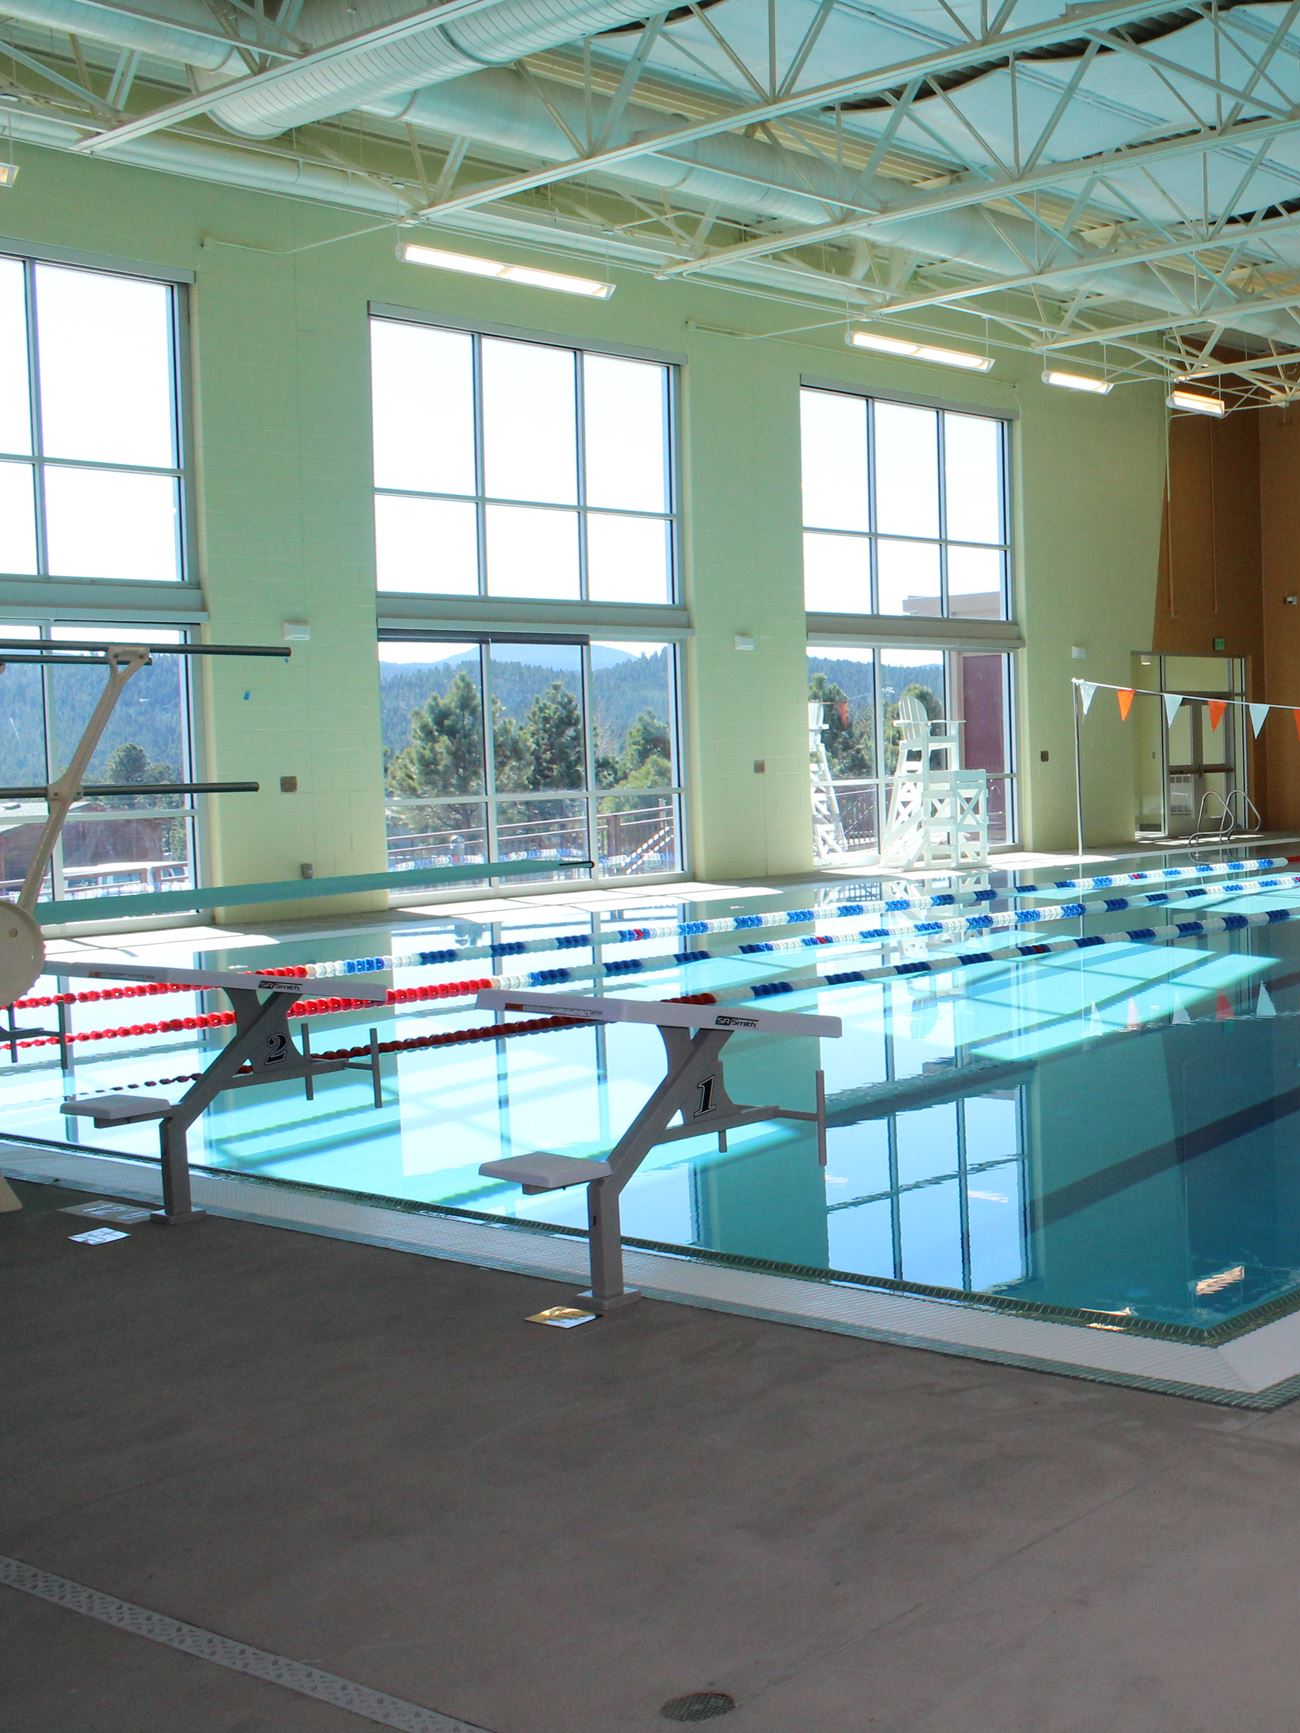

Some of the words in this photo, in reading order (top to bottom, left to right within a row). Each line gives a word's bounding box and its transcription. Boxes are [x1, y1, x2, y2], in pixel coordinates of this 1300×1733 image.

[274, 983, 300, 991] Smith
[716, 1015, 731, 1026] SR
[731, 1018, 757, 1028] Smith
[265, 1032, 289, 1066] 2
[693, 1073, 717, 1117] 1
